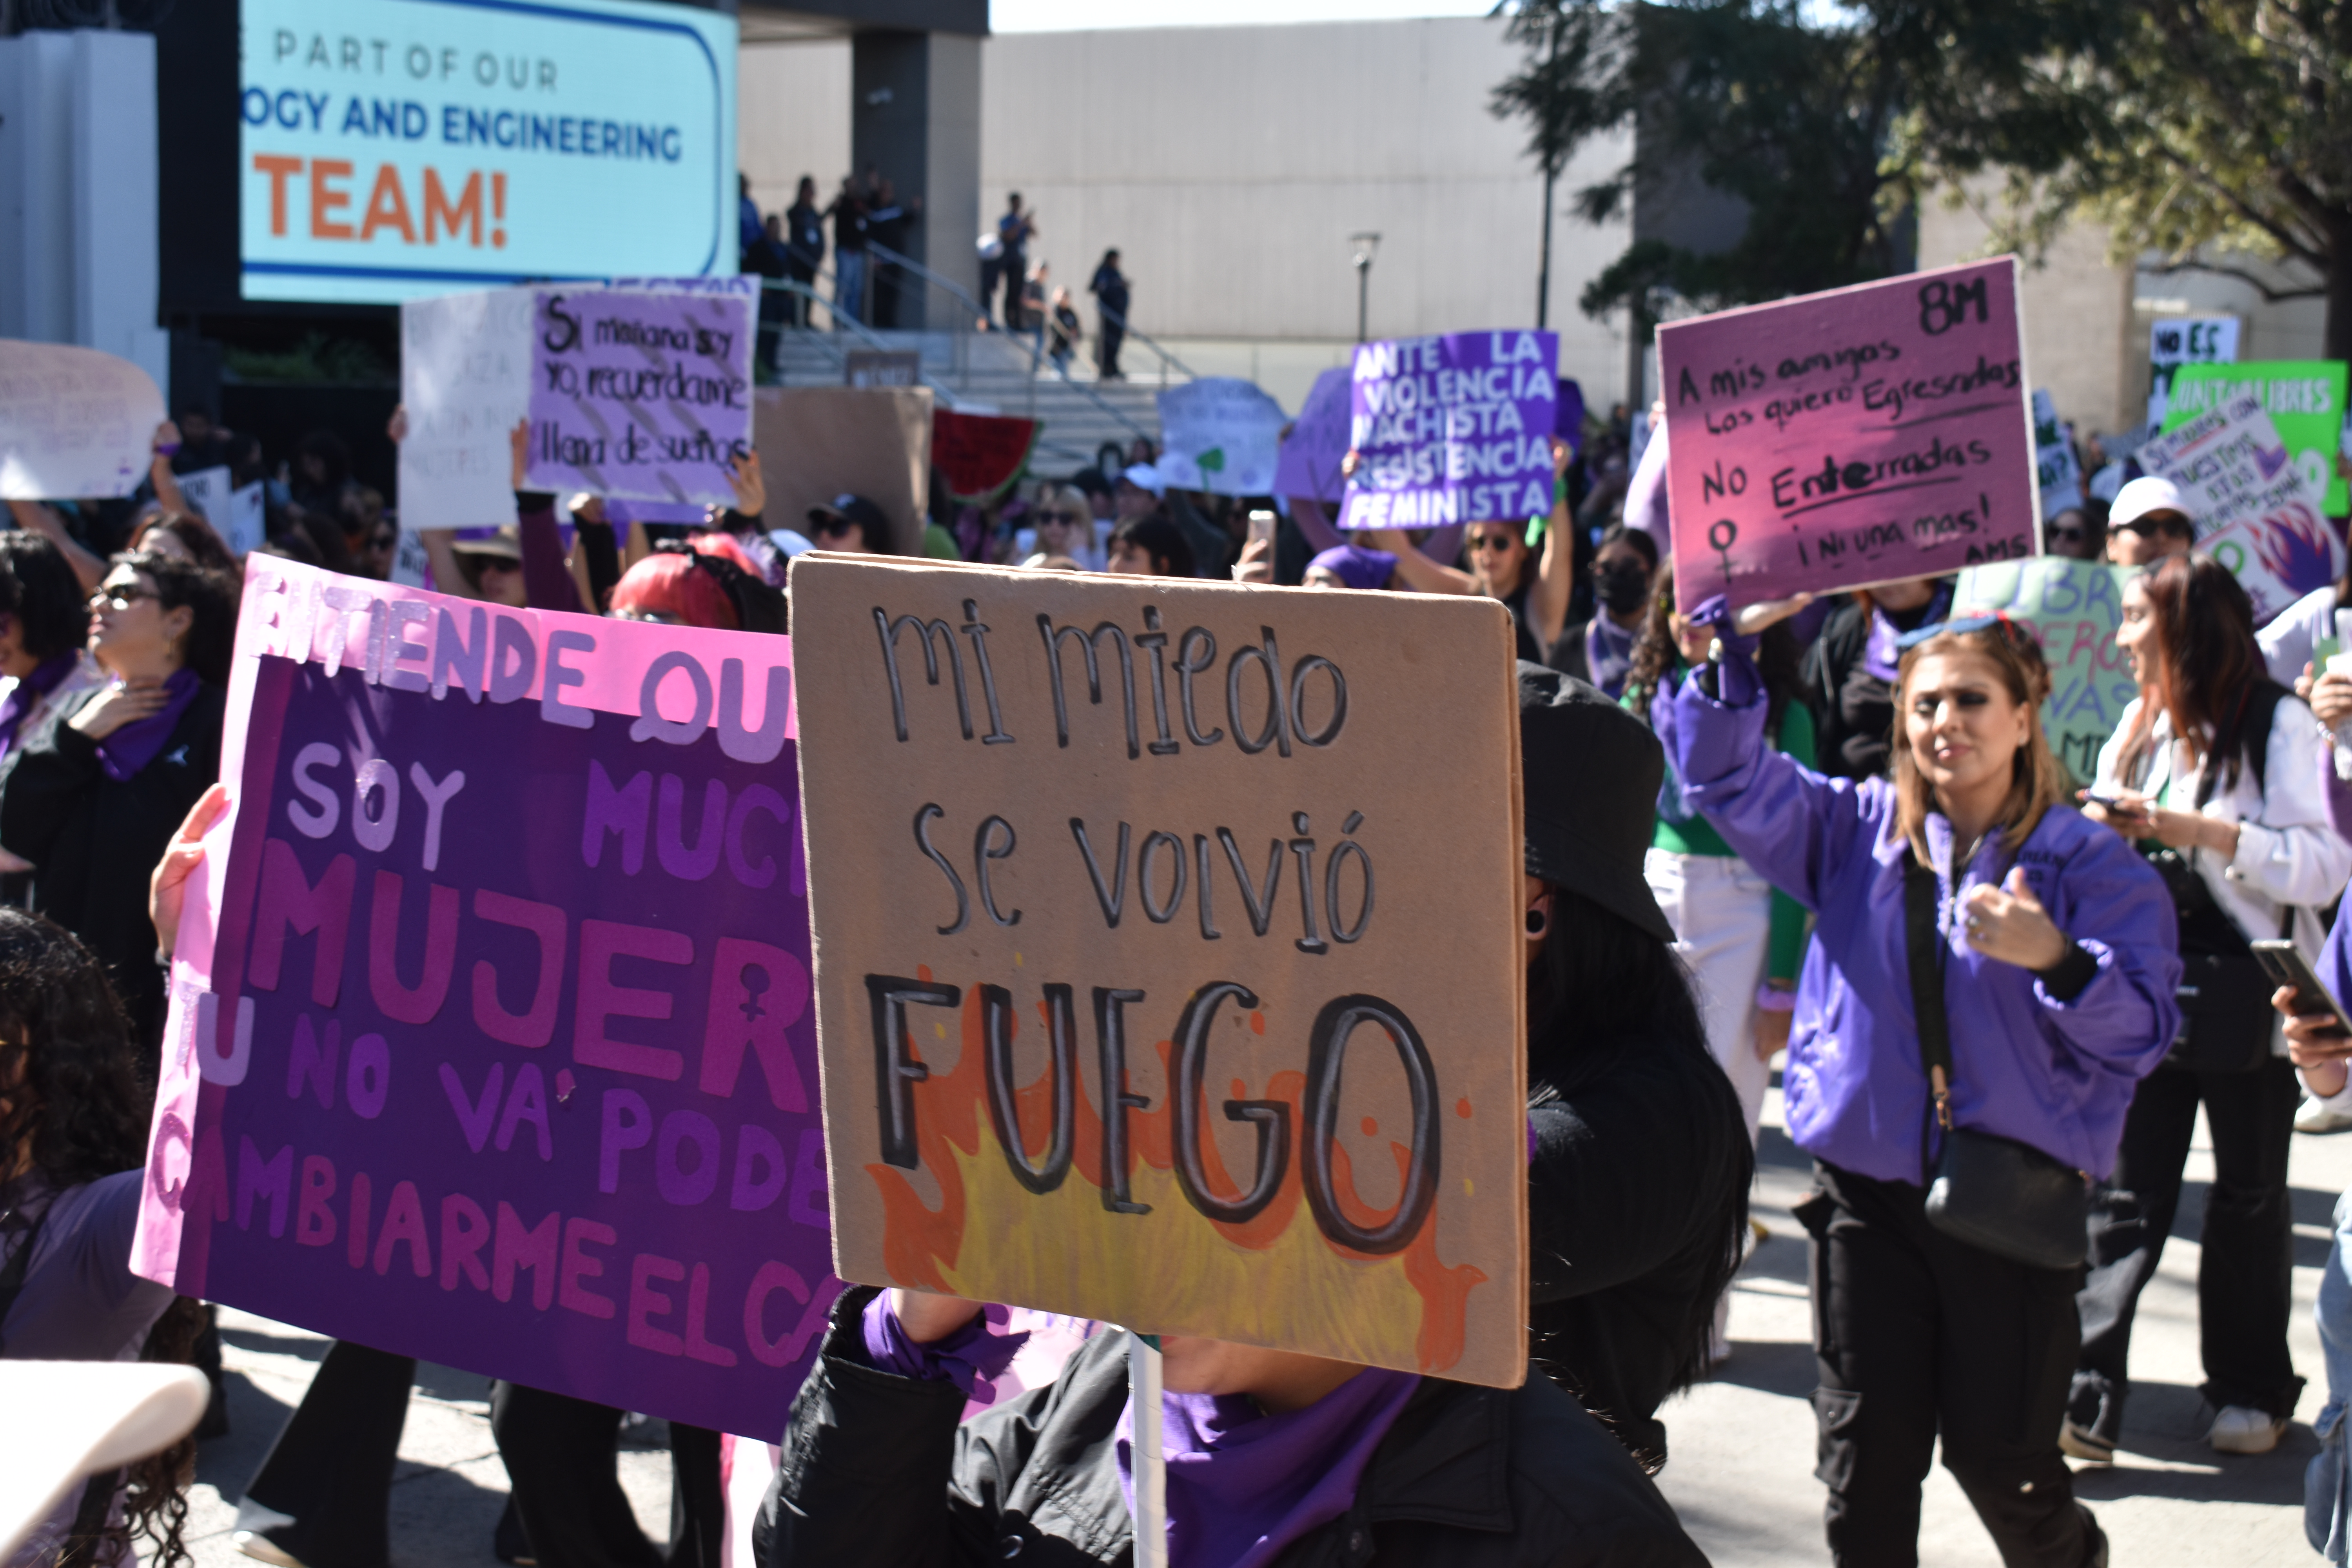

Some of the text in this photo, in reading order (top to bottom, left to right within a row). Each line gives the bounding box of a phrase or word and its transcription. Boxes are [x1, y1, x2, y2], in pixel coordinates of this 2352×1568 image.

[274, 28, 390, 75] PART
[406, 43, 458, 83] OF
[474, 50, 558, 93] OUR
[341, 95, 429, 140] AND
[442, 105, 682, 163] ENGINEERING
[253, 153, 508, 250] TEAM!
[1917, 276, 1989, 336] 8M
[2189, 322, 2220, 357] ES
[1353, 331, 1543, 383] ANTE LA
[1363, 365, 1556, 415] VIOLENCIA
[616, 422, 651, 465] de
[1347, 479, 1550, 528] FEMINISTA
[1971, 562, 2122, 628] LIBR
[249, 570, 791, 764] ENTIENDE QU
[871, 597, 1349, 760] mi miedo
[287, 742, 466, 872] SOY
[1068, 808, 1375, 956] volvió
[247, 837, 811, 1114] MUJER
[287, 1013, 390, 1119] NO
[599, 1088, 830, 1231] PODE
[864, 973, 1443, 1256] FUEGO
